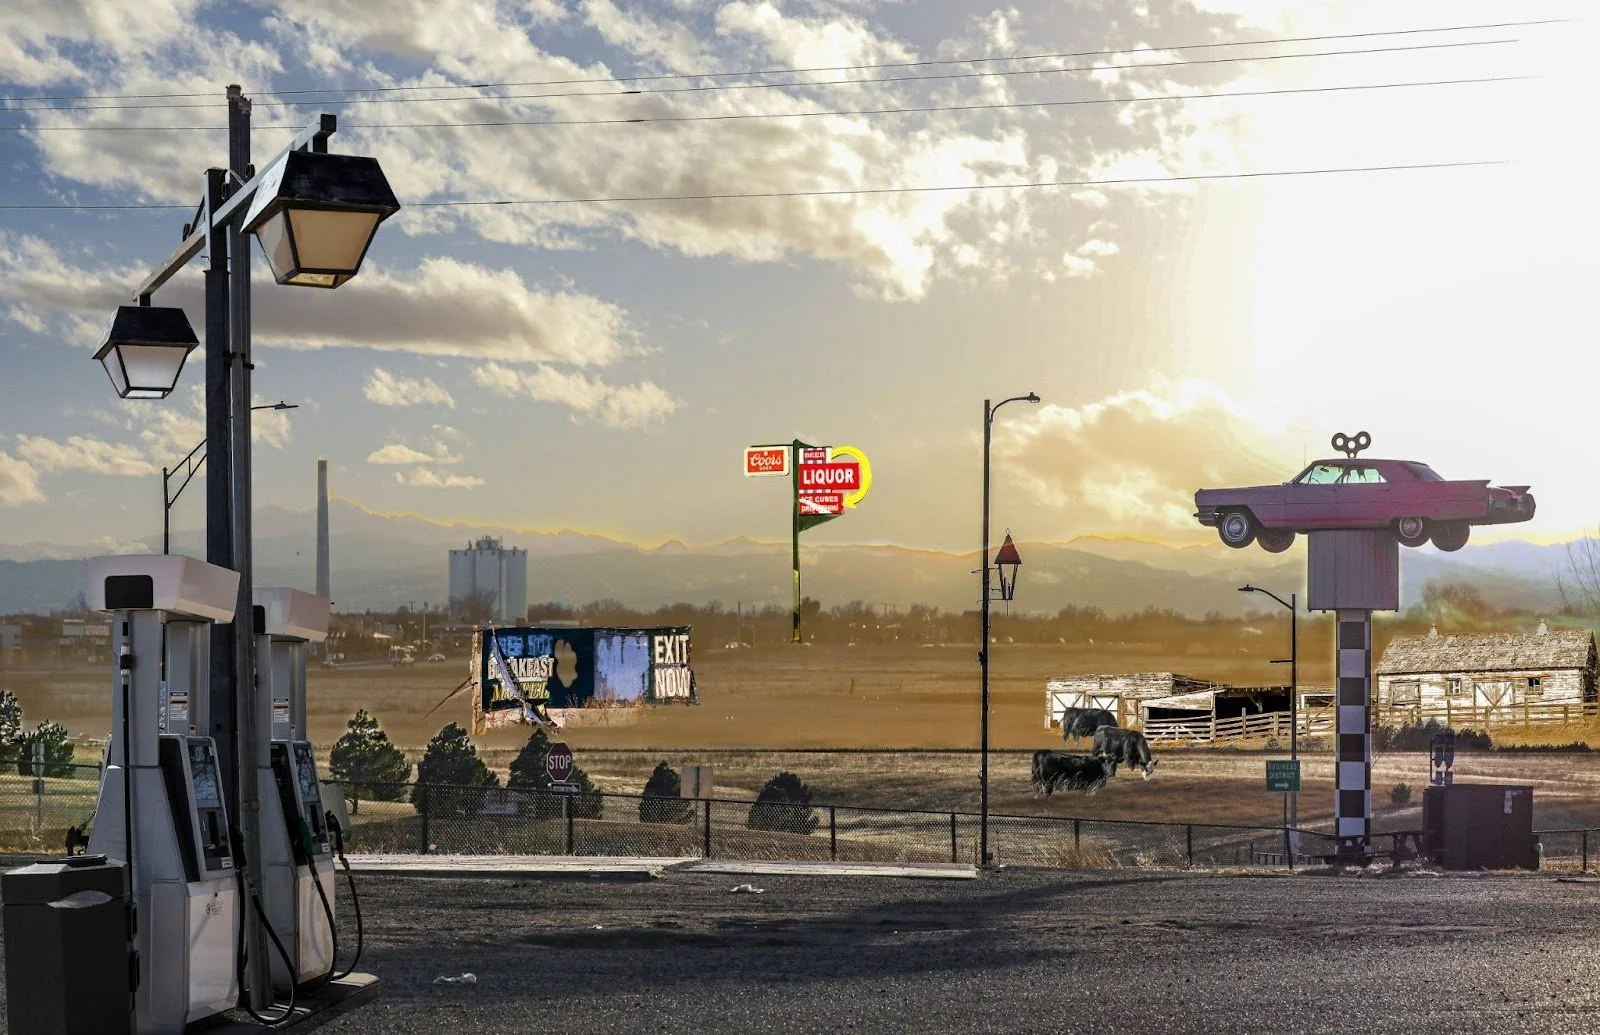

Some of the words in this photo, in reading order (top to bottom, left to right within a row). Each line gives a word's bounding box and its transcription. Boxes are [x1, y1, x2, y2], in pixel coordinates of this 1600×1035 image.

[750, 453, 782, 467] Coors
[804, 451, 825, 459] BEER
[803, 468, 854, 485] LIQUOR
[654, 635, 689, 664] EXIT
[655, 668, 691, 698] NOW
[548, 755, 571, 770] STOP
[1268, 762, 1297, 770] BUSINESS
[1269, 771, 1295, 779] DISTRICT
